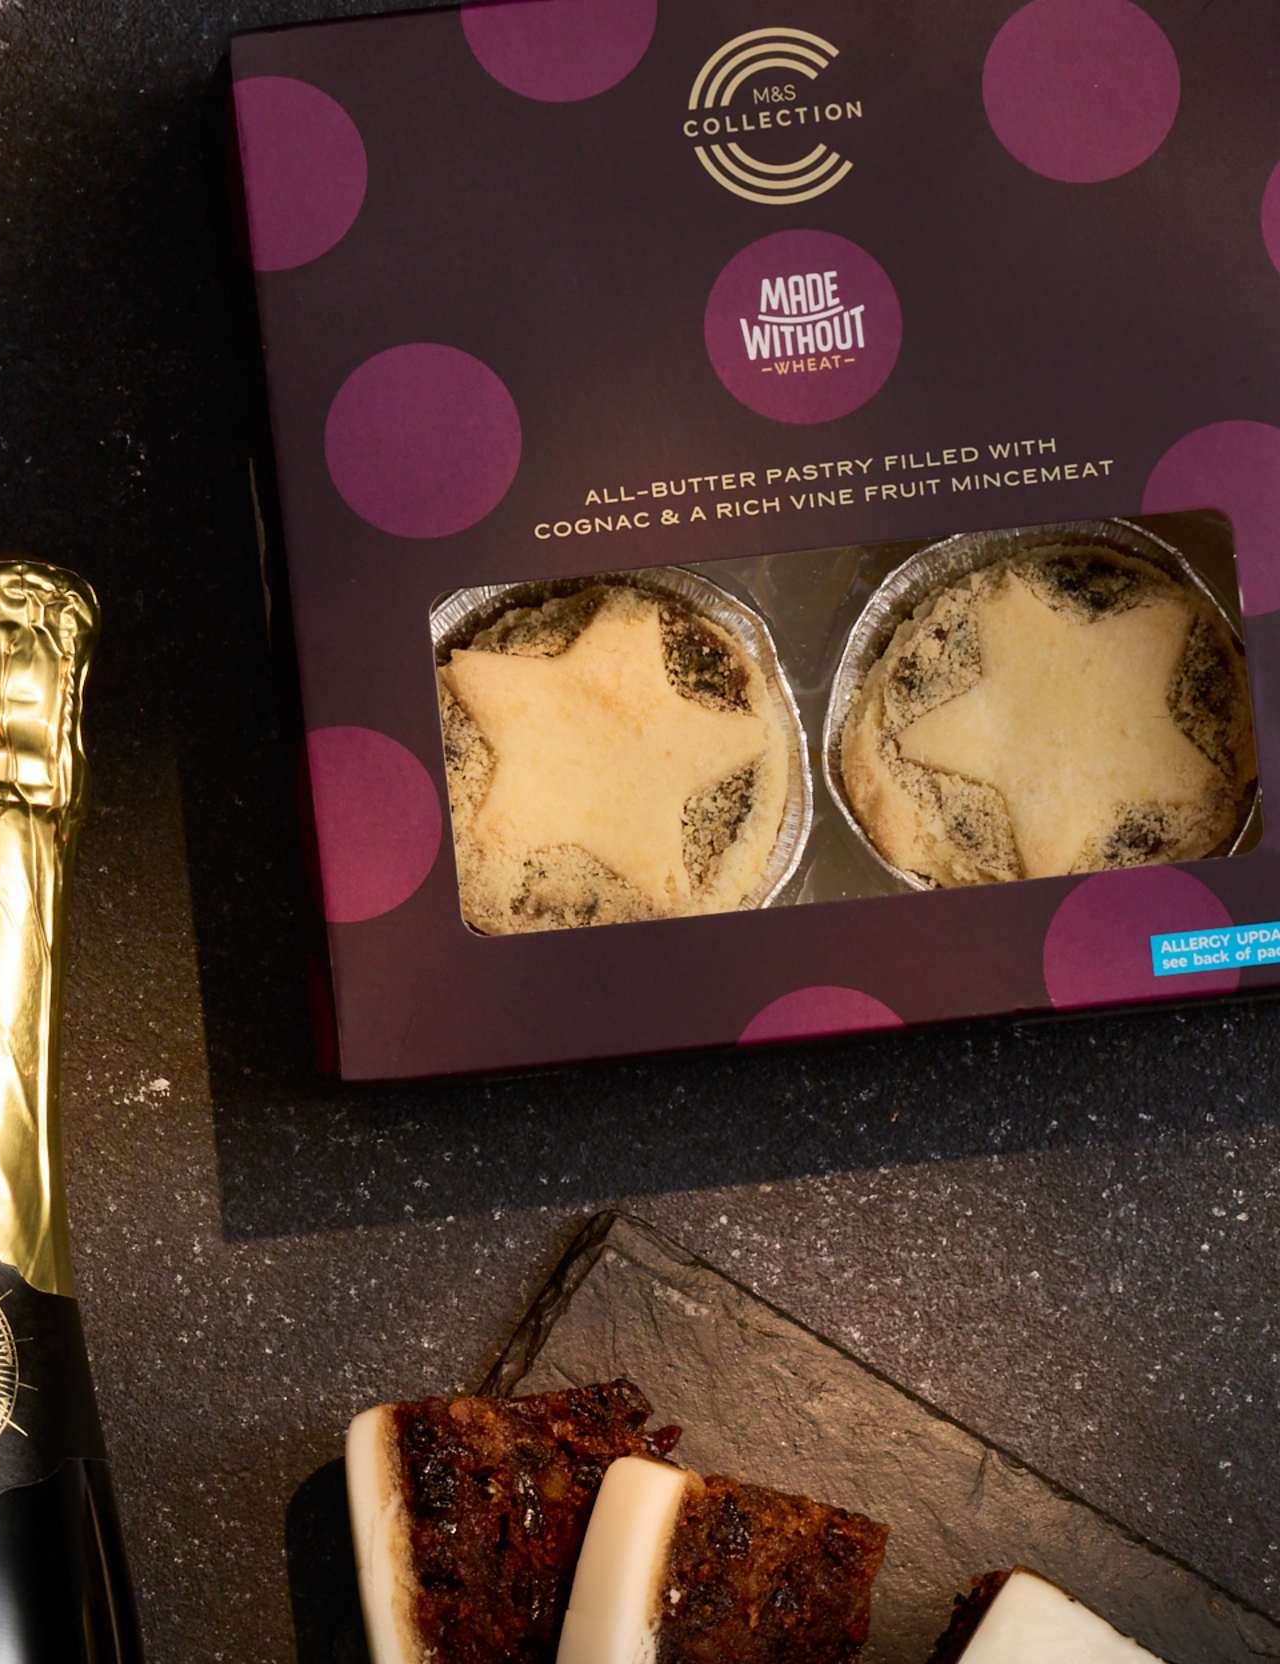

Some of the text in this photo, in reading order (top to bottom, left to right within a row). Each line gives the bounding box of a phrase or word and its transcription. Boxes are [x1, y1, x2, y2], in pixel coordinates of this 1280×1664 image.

[753, 84, 797, 105] M&S
[683, 101, 863, 137] COLLECTION
[760, 271, 841, 315] MADE
[739, 304, 865, 360] WITHOUT
[585, 437, 1057, 506] ALL-BUTTER PASTRY FILLED WITH
[534, 460, 1114, 540] COGNAC & A RICH VINE FRUIT MINCEMEAT
[1161, 934, 1230, 954] ALLERGY
[1162, 957, 1188, 969] see
[1193, 950, 1230, 966] back
[1235, 946, 1252, 961] of
